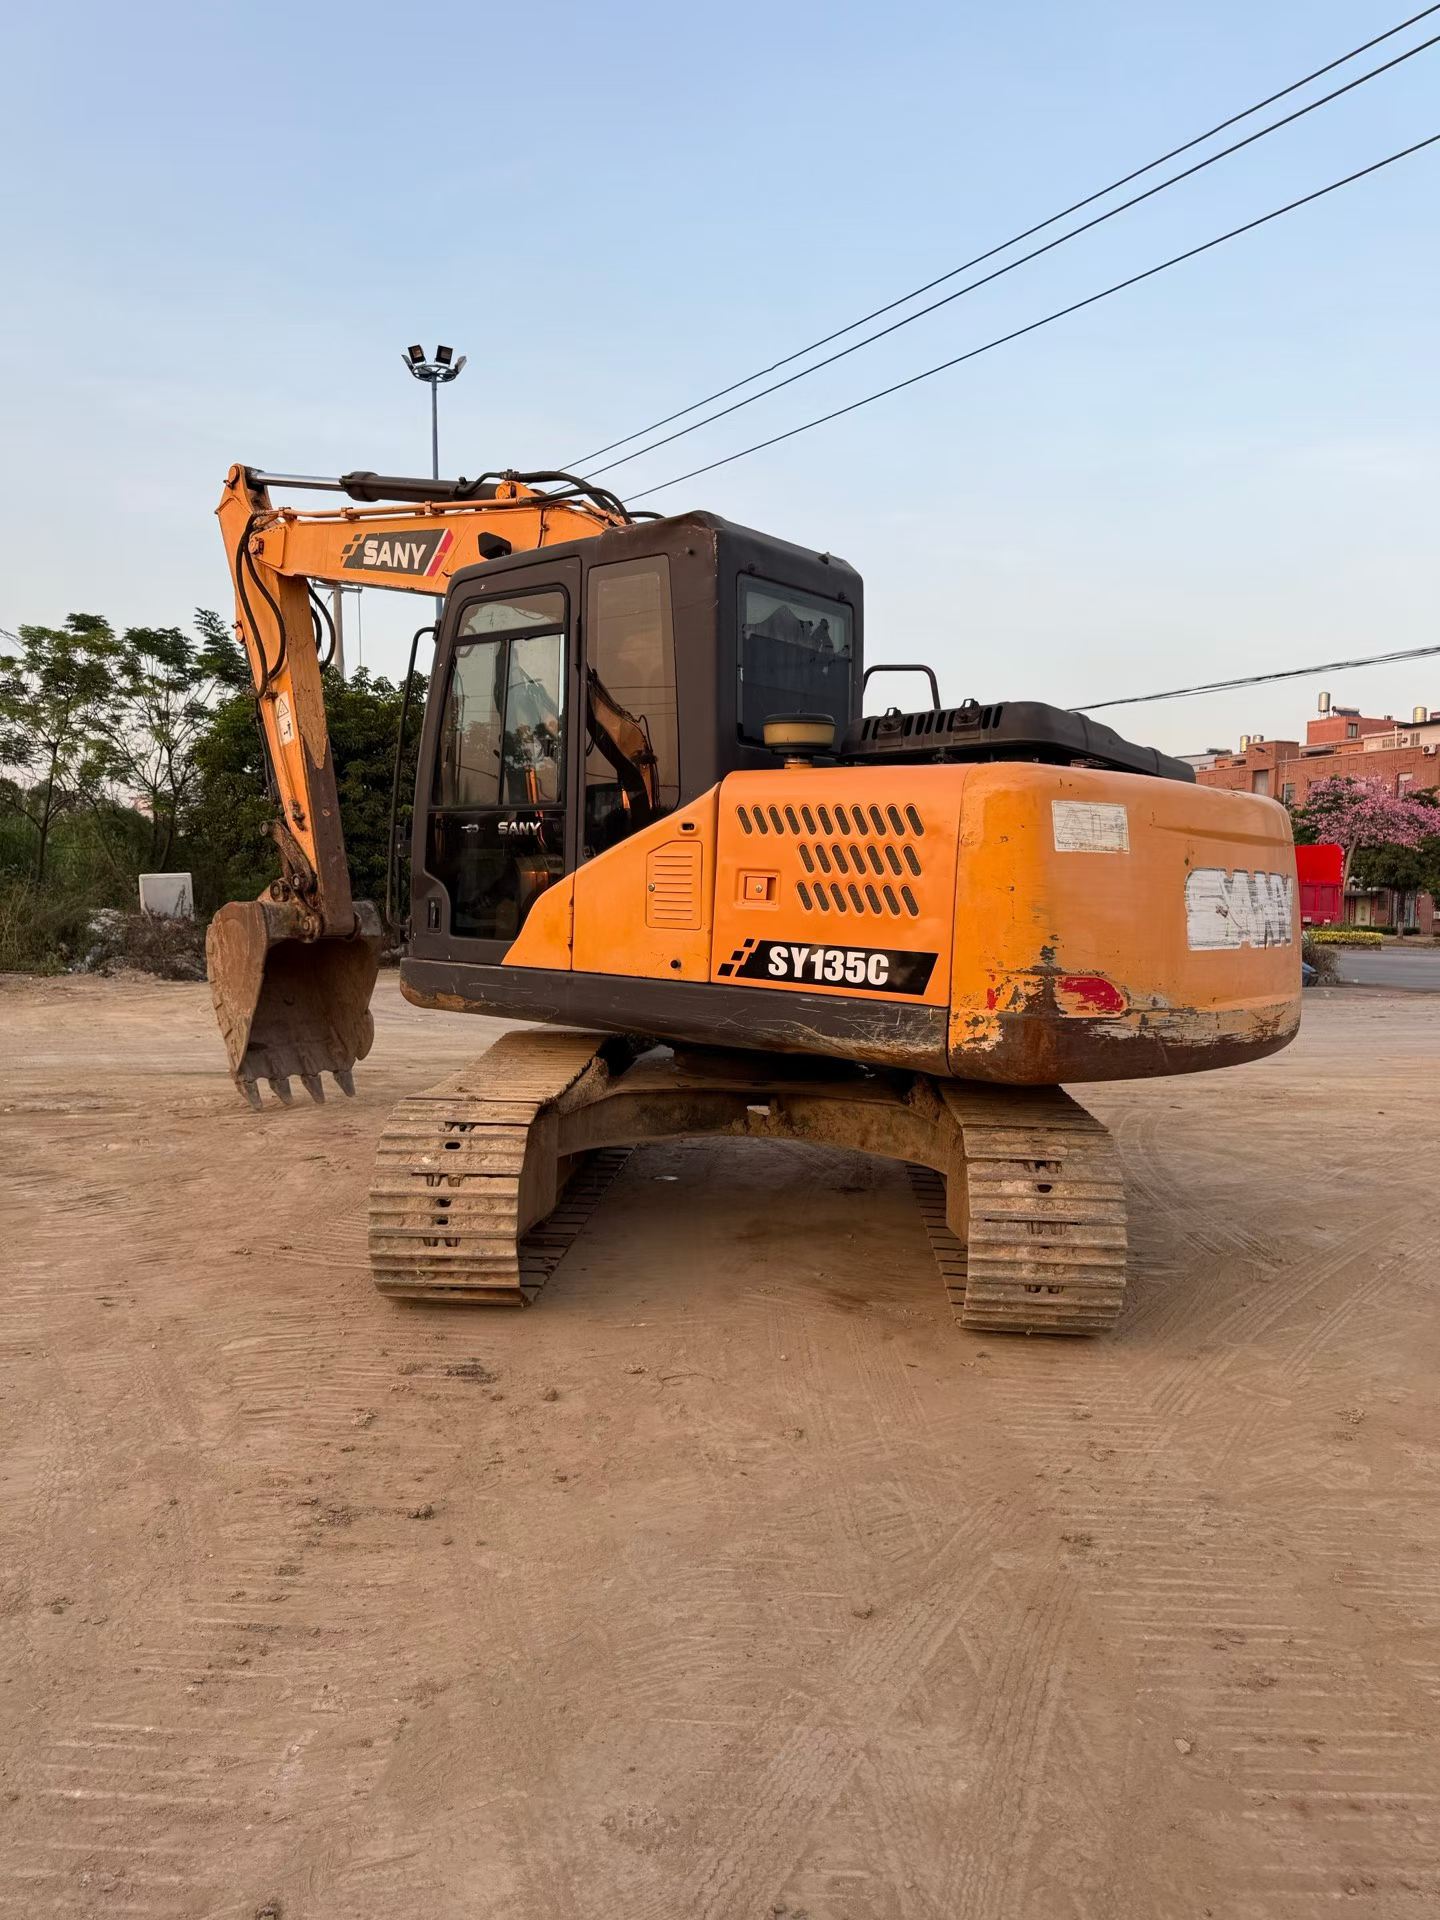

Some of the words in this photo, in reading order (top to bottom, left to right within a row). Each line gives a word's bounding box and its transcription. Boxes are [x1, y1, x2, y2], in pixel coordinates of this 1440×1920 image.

[363, 540, 427, 569] SANY
[498, 821, 541, 836] SANY
[768, 945, 889, 986] SY135C
